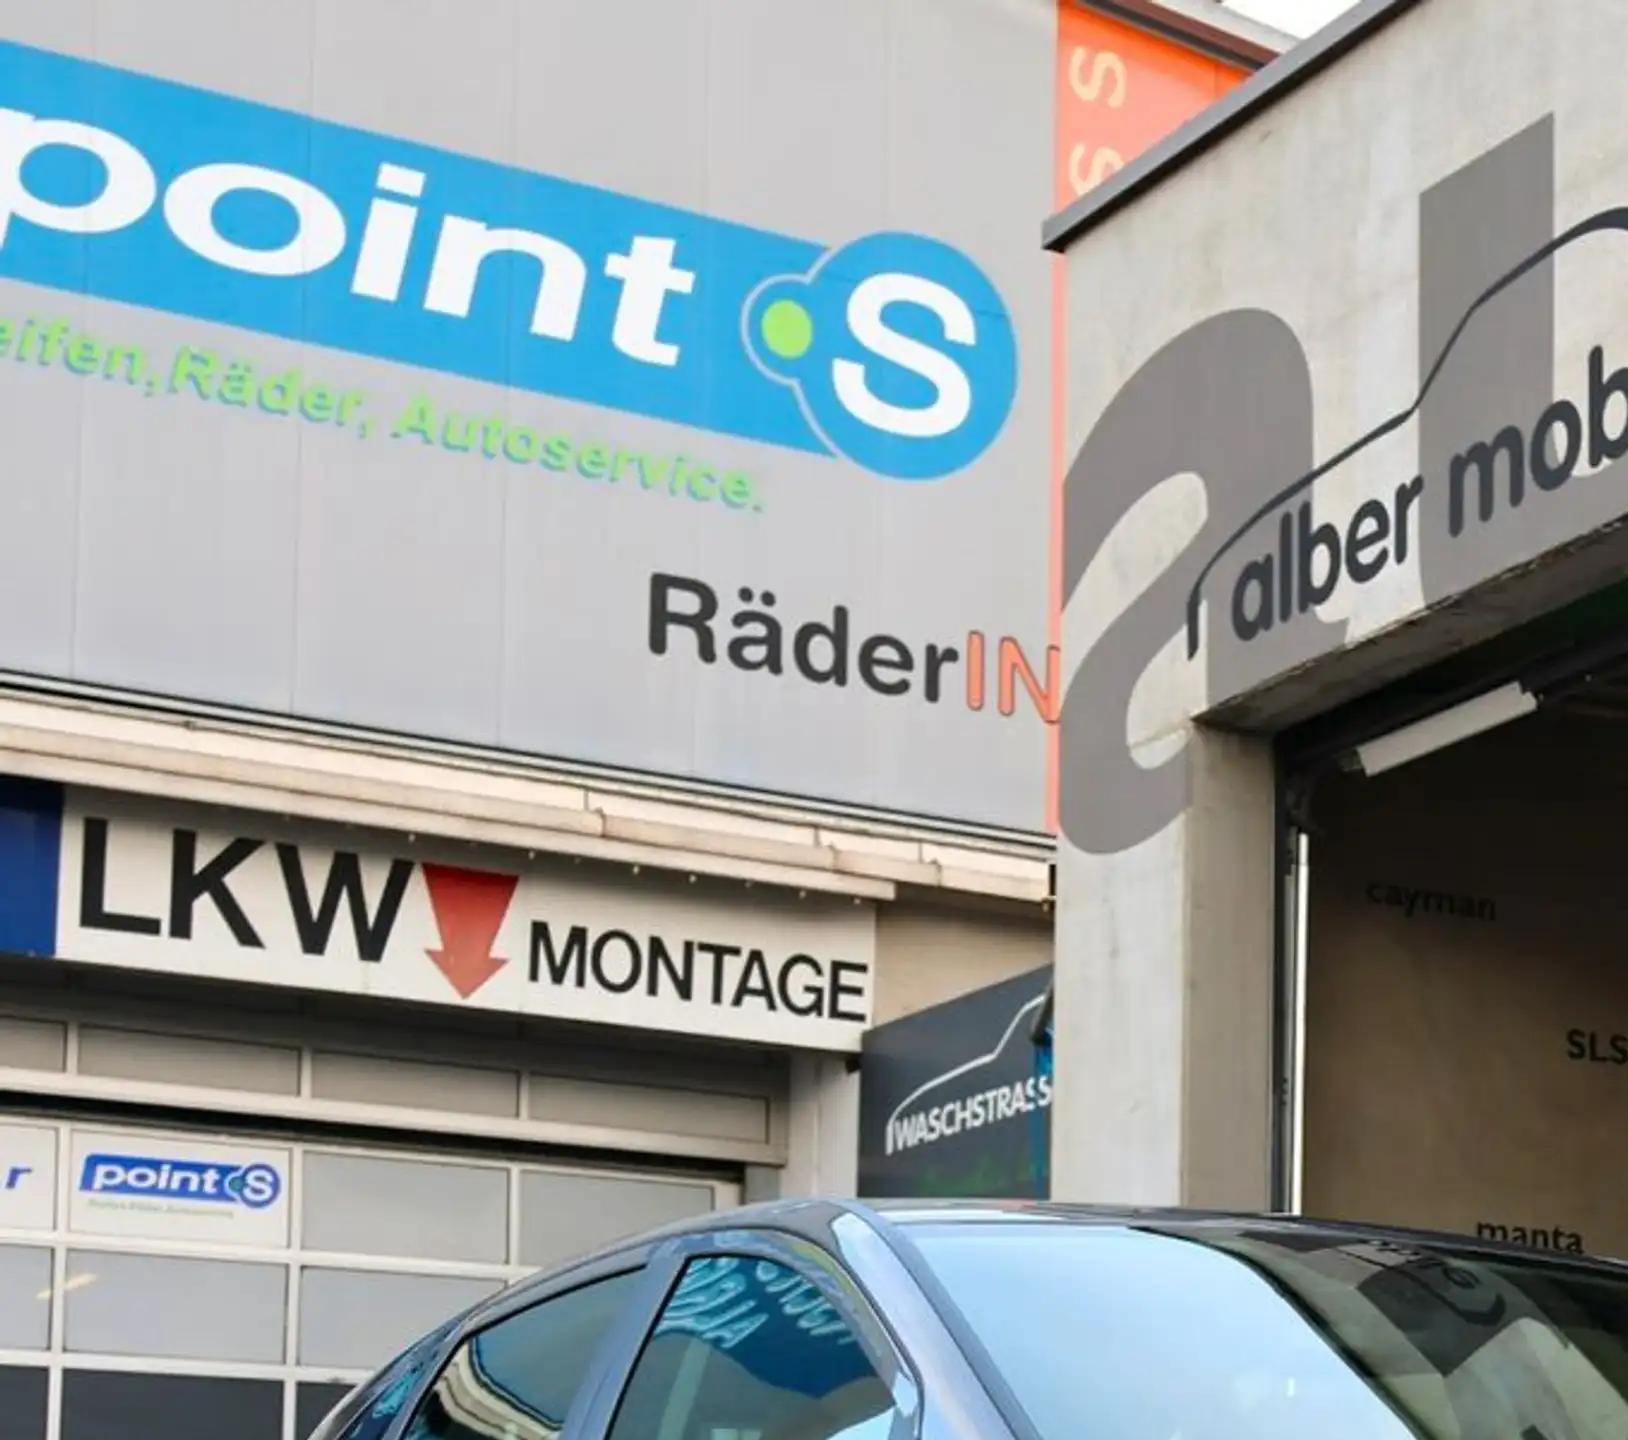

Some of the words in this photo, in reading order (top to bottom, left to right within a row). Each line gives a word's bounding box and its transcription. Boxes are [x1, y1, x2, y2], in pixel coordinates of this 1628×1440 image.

[0, 107, 697, 368] point
[832, 273, 977, 438] S
[390, 394, 766, 514] Autoservice.
[1230, 476, 1423, 641] alber
[79, 817, 415, 963] LKW
[528, 920, 869, 1023] MONTAGE
[1365, 881, 1498, 921] cayman
[1566, 1028, 1628, 1065] SLS
[92, 1163, 221, 1194] point
[241, 1169, 275, 1202] S
[1476, 1222, 1585, 1253] manta
